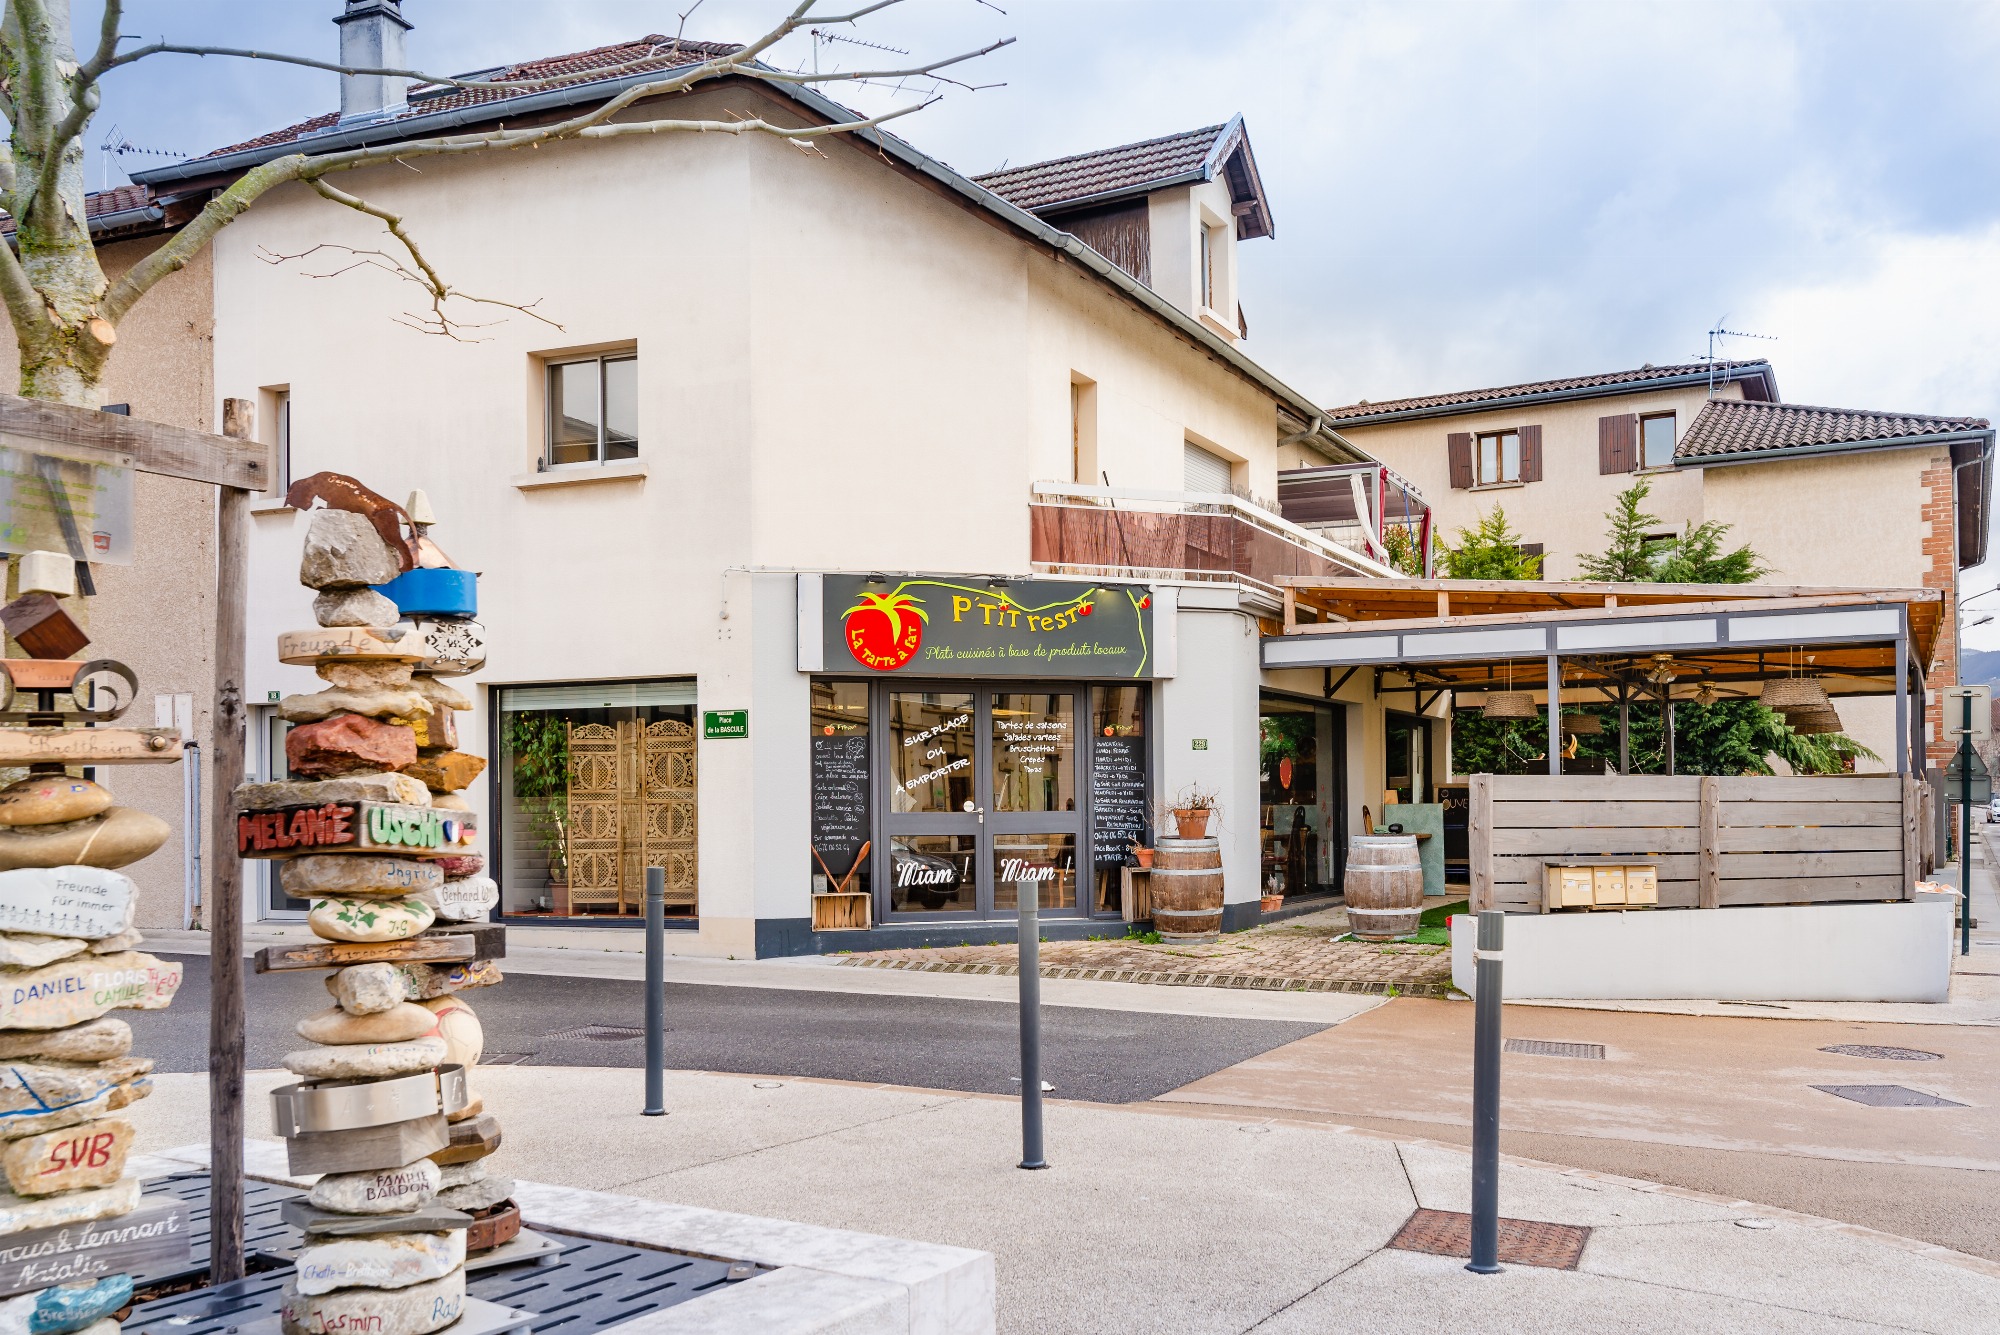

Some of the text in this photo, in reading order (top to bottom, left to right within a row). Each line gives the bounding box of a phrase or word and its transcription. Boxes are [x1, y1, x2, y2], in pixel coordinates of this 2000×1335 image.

[283, 631, 371, 656] Freunde
[926, 642, 1127, 662] Plats cuisinés à base de produits locaux
[904, 713, 969, 747] SUR PLACE
[996, 720, 1067, 730] Tartes de saisons
[1003, 732, 1032, 742] Salades
[1010, 744, 1055, 752] Bruschettas
[926, 747, 946, 760] OU
[906, 758, 970, 789] EMPORTER
[1024, 766, 1042, 774] Tapas
[387, 862, 438, 886] Ingrid
[896, 861, 954, 888] Miam
[1000, 858, 1056, 882] Miam
[56, 880, 108, 896] Freunde
[442, 886, 479, 902] Gerhard
[52, 896, 116, 912] für immer
[14, 977, 86, 1005] DANIEL
[93, 970, 148, 989] FLORIS
[94, 984, 146, 1006] CAMILLE
[40, 1132, 115, 1176] SVB
[366, 1183, 430, 1200] BARDON
[75, 1210, 180, 1250] Lennart
[312, 1308, 382, 1332] Jasmin
